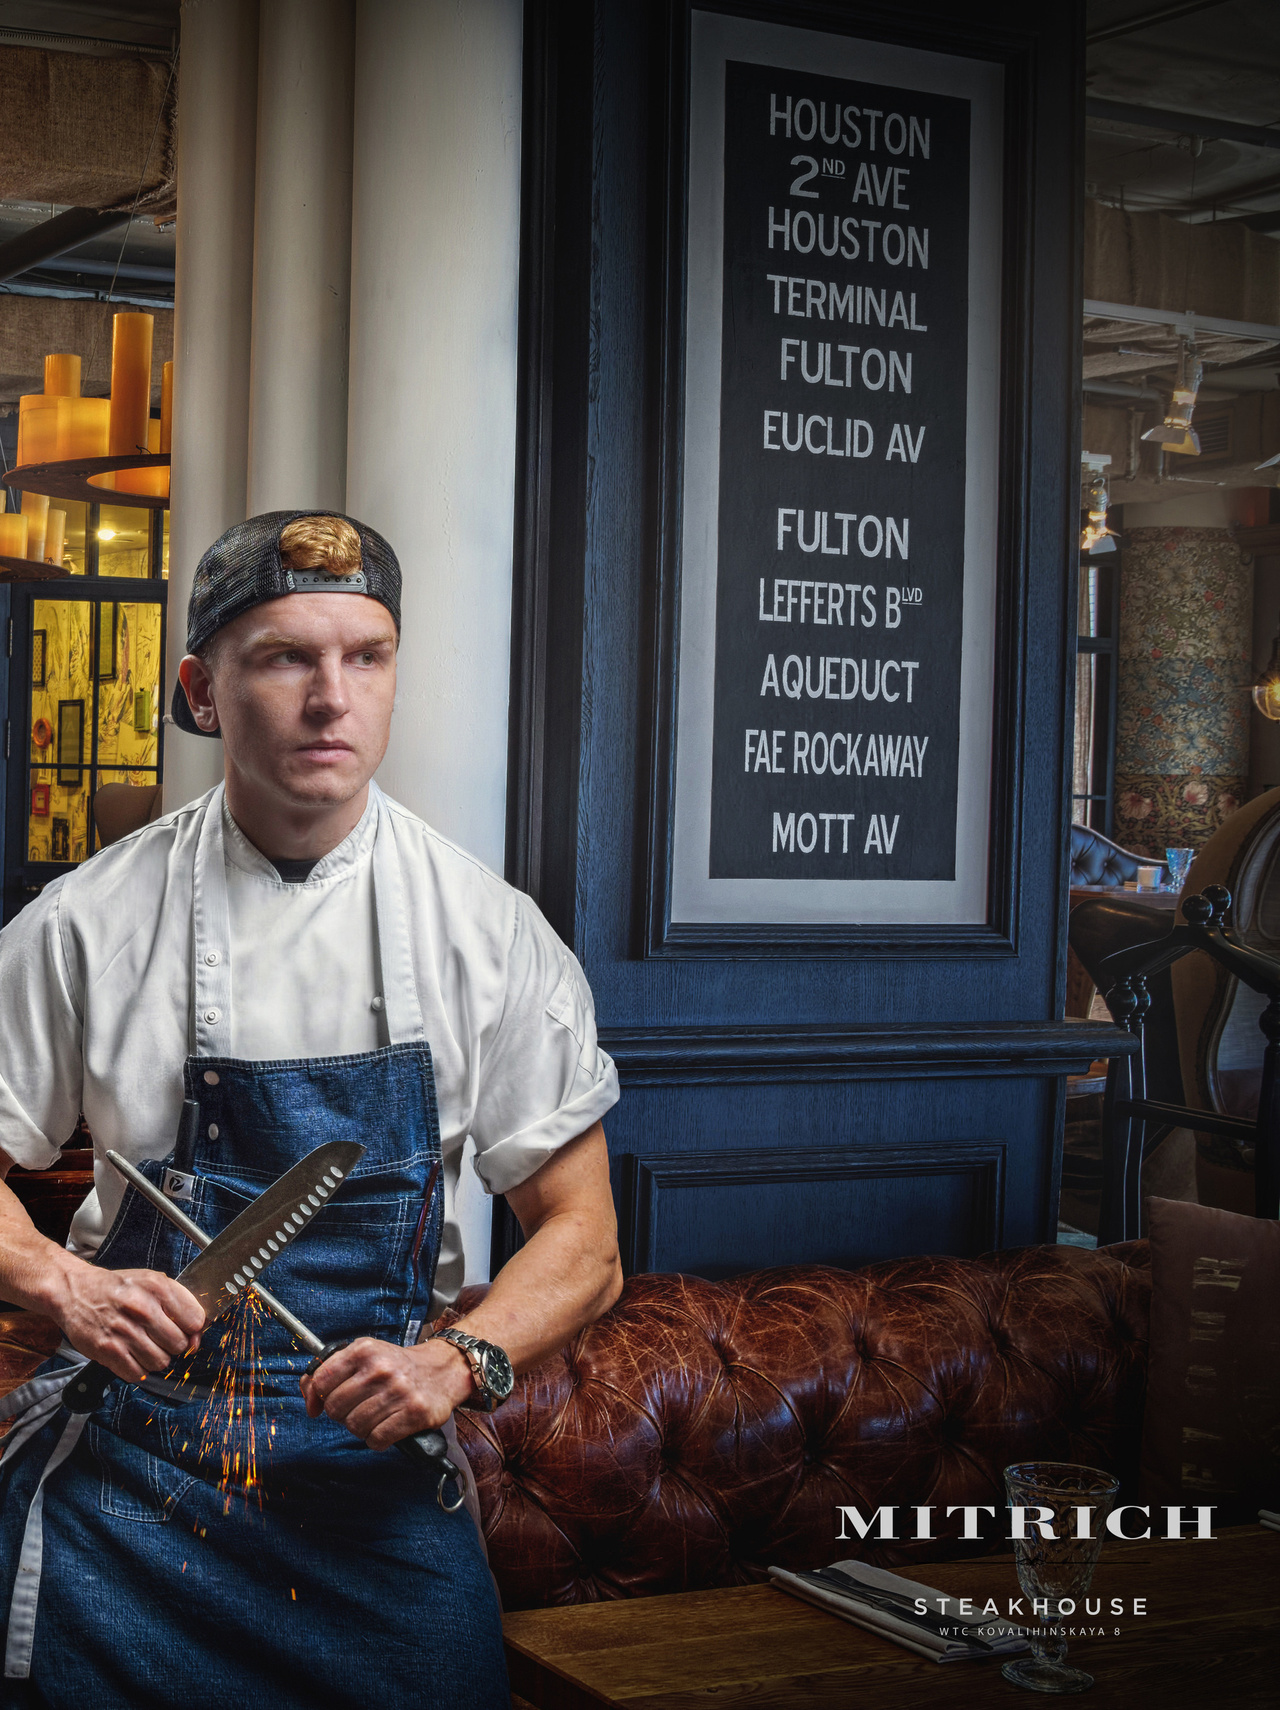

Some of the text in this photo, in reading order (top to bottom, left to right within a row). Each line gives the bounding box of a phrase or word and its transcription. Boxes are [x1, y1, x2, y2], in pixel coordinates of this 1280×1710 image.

[769, 93, 930, 159] HOUSTON
[852, 163, 909, 210] AVE
[768, 206, 928, 269] HOUSTON
[767, 274, 927, 331] TERMINAL
[781, 338, 912, 393] FULTON
[764, 410, 925, 463] EUCLID AV
[778, 508, 908, 559] FULTON
[759, 578, 876, 627] LEFFERTS
[761, 654, 919, 702] AQUEDUCT
[745, 729, 928, 777] FAE ROCKAWAY
[773, 812, 899, 854] MOTT AV
